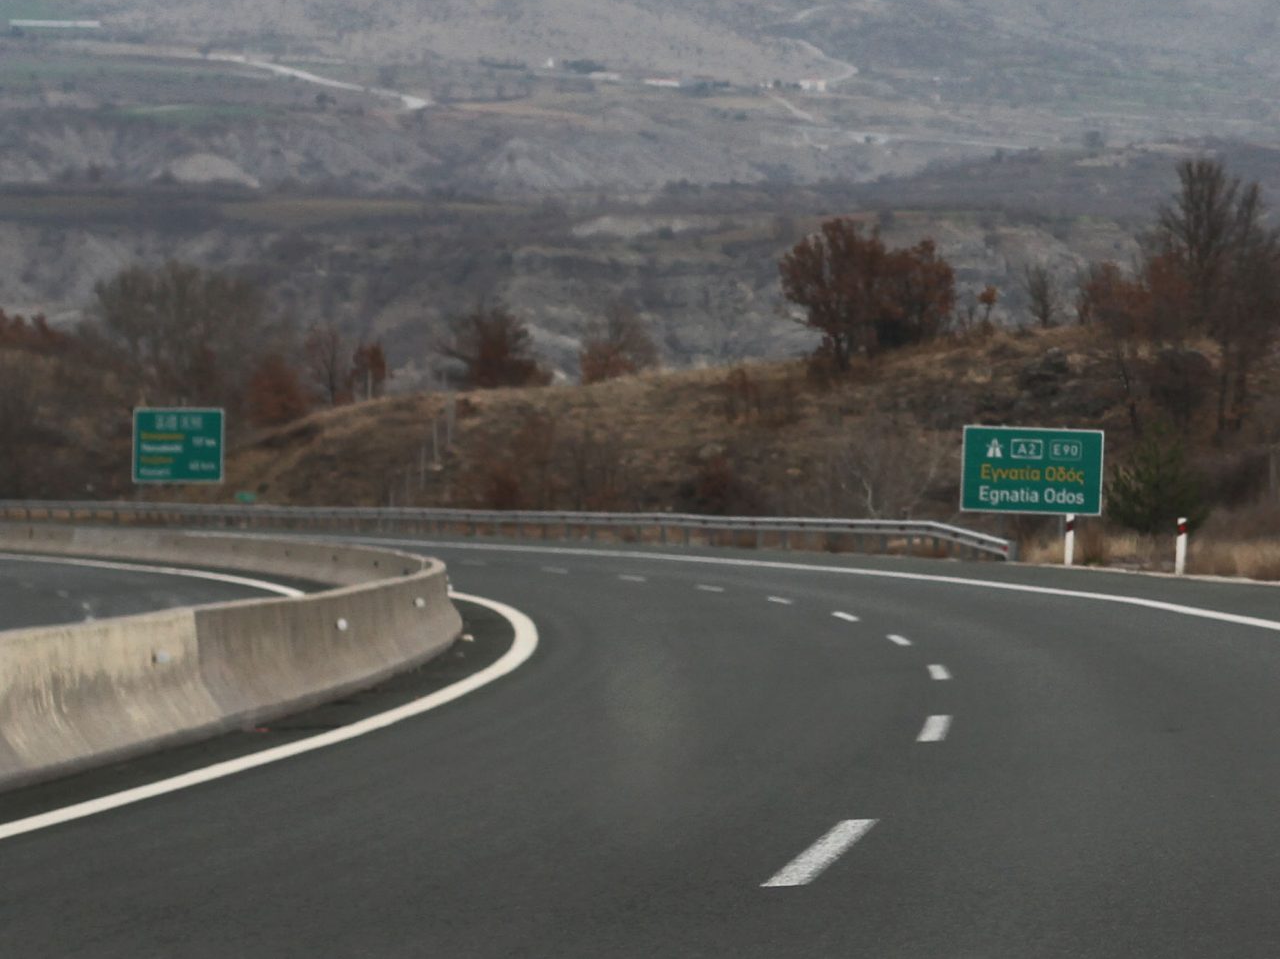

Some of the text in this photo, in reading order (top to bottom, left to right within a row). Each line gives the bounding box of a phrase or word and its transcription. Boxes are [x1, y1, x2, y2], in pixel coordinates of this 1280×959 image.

[1017, 442, 1037, 456] A2
[980, 463, 1085, 486] Εγνατία Οδός
[979, 485, 1085, 505] Egnatia Odos
